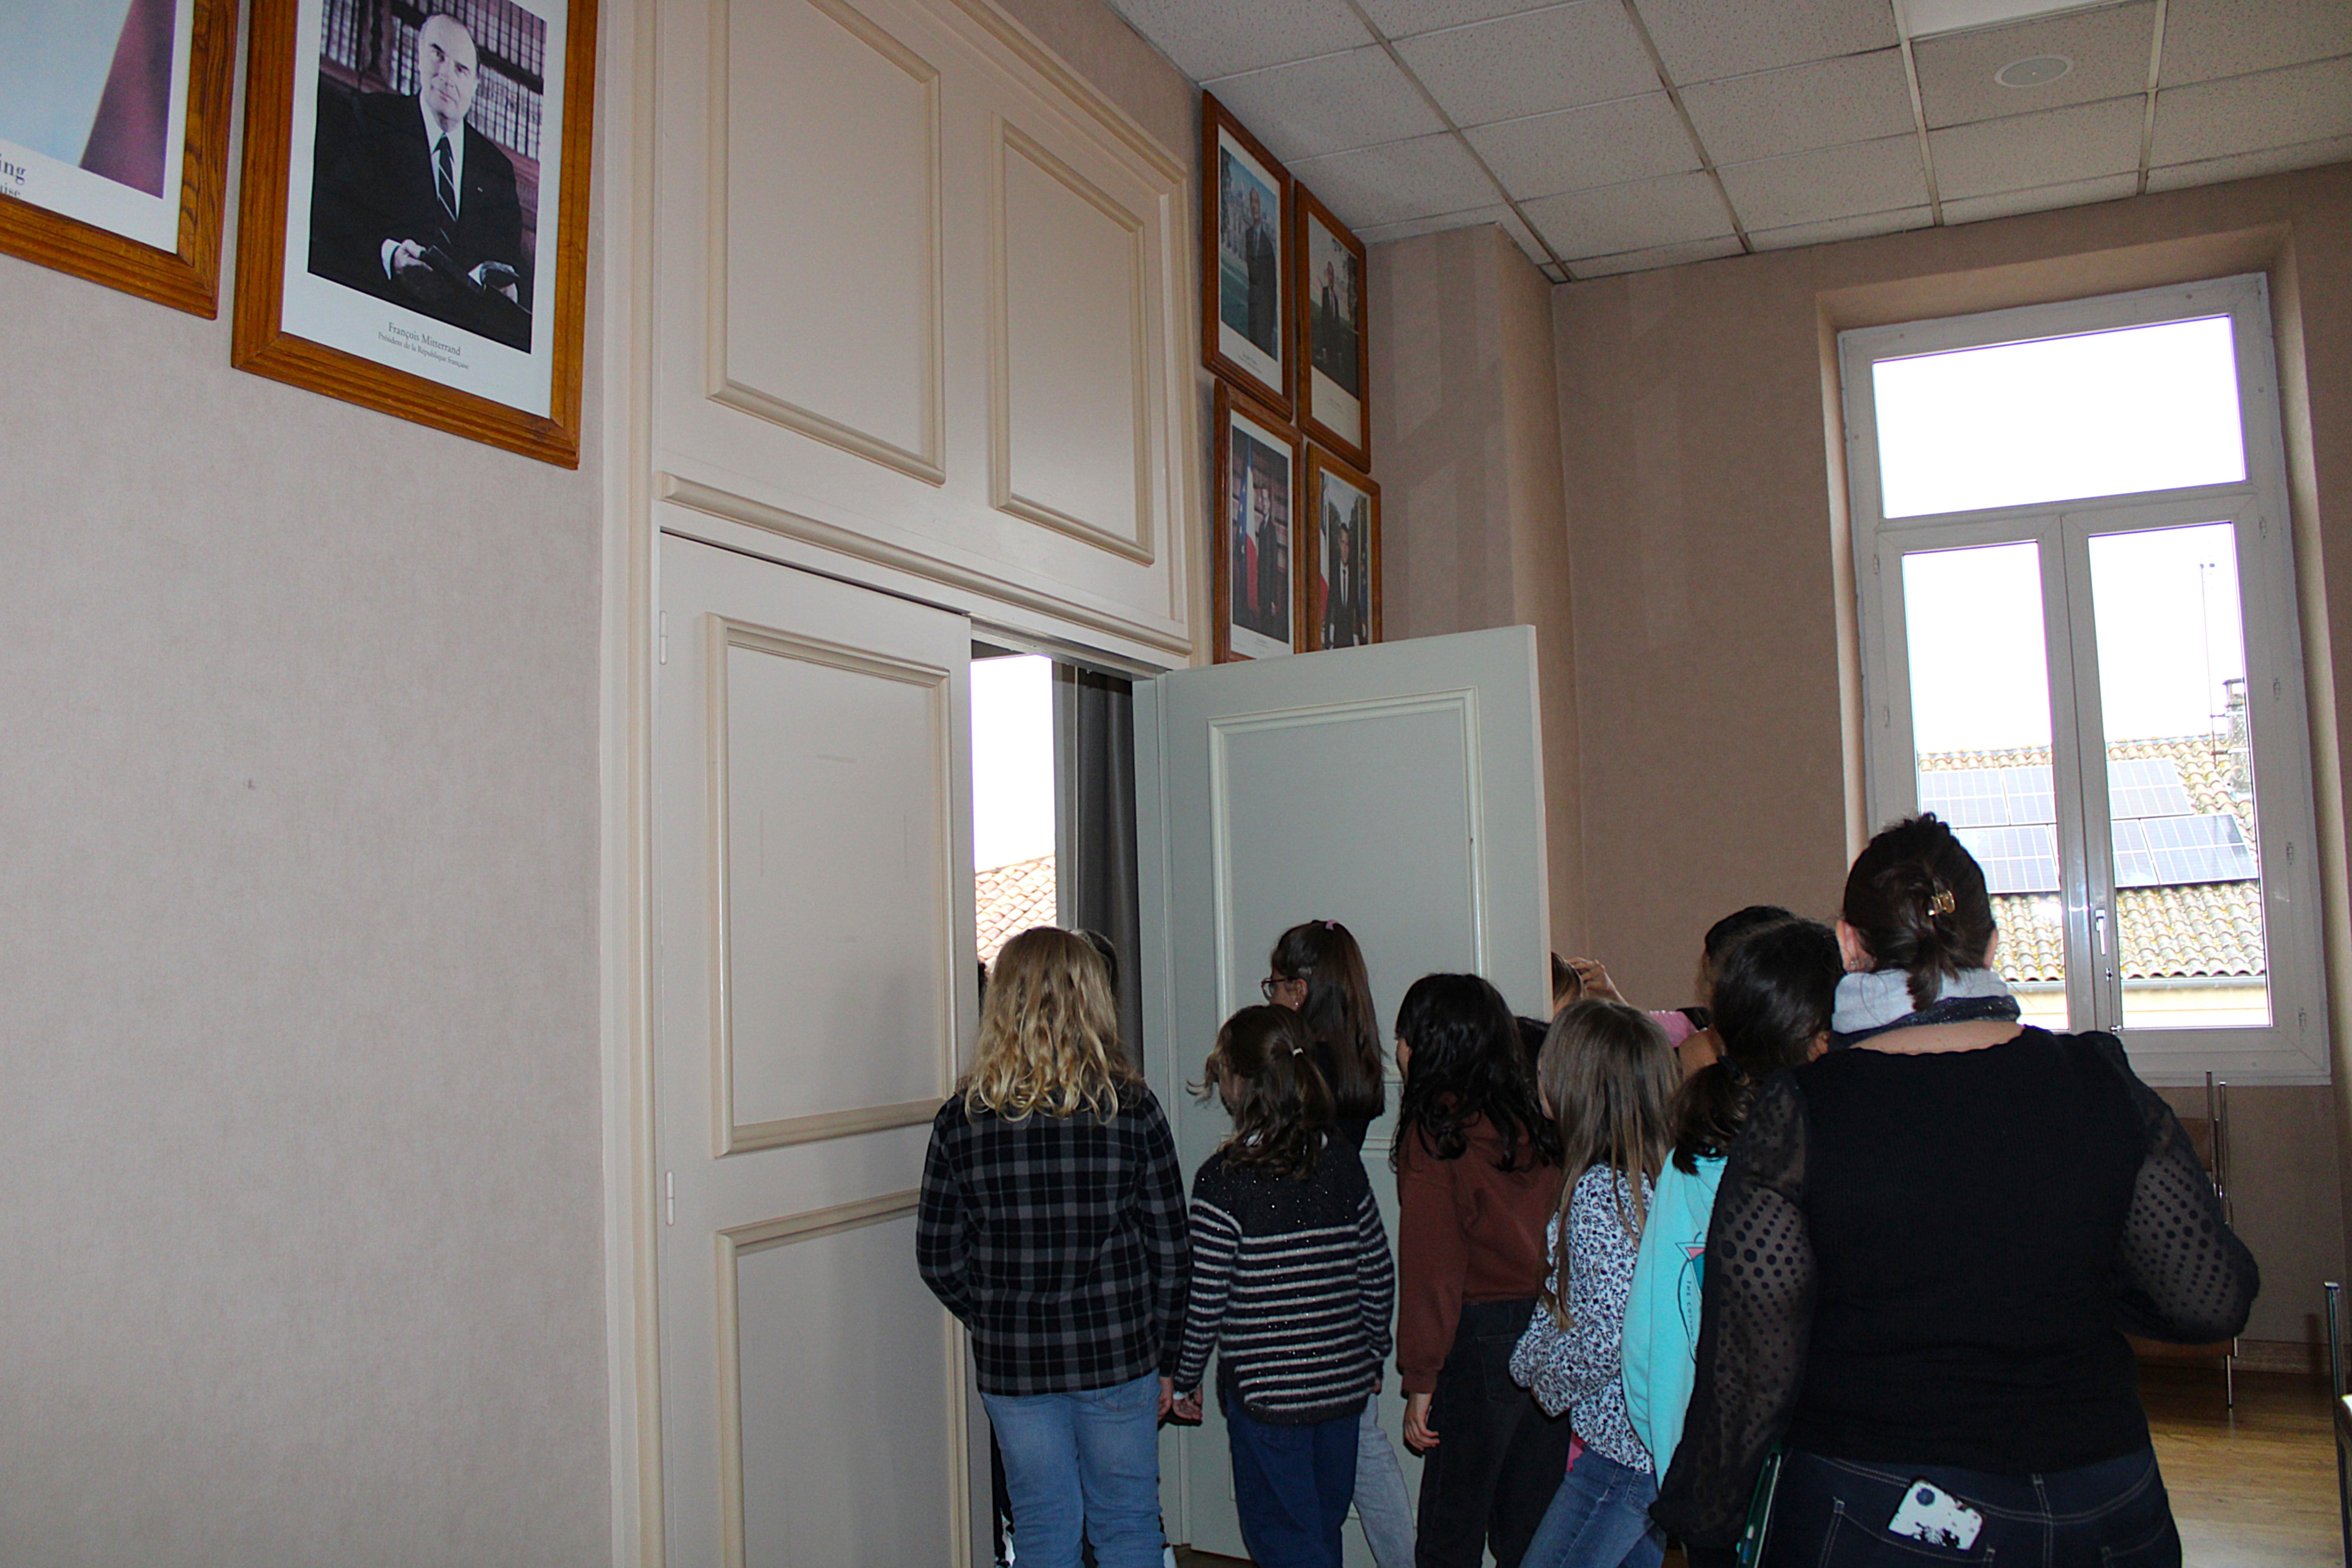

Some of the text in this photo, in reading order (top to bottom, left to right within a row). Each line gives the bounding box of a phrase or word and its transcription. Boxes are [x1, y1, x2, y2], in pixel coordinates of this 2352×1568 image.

[378, 331, 469, 369] Président de la République française
[389, 322, 461, 356] François Mitterrand
